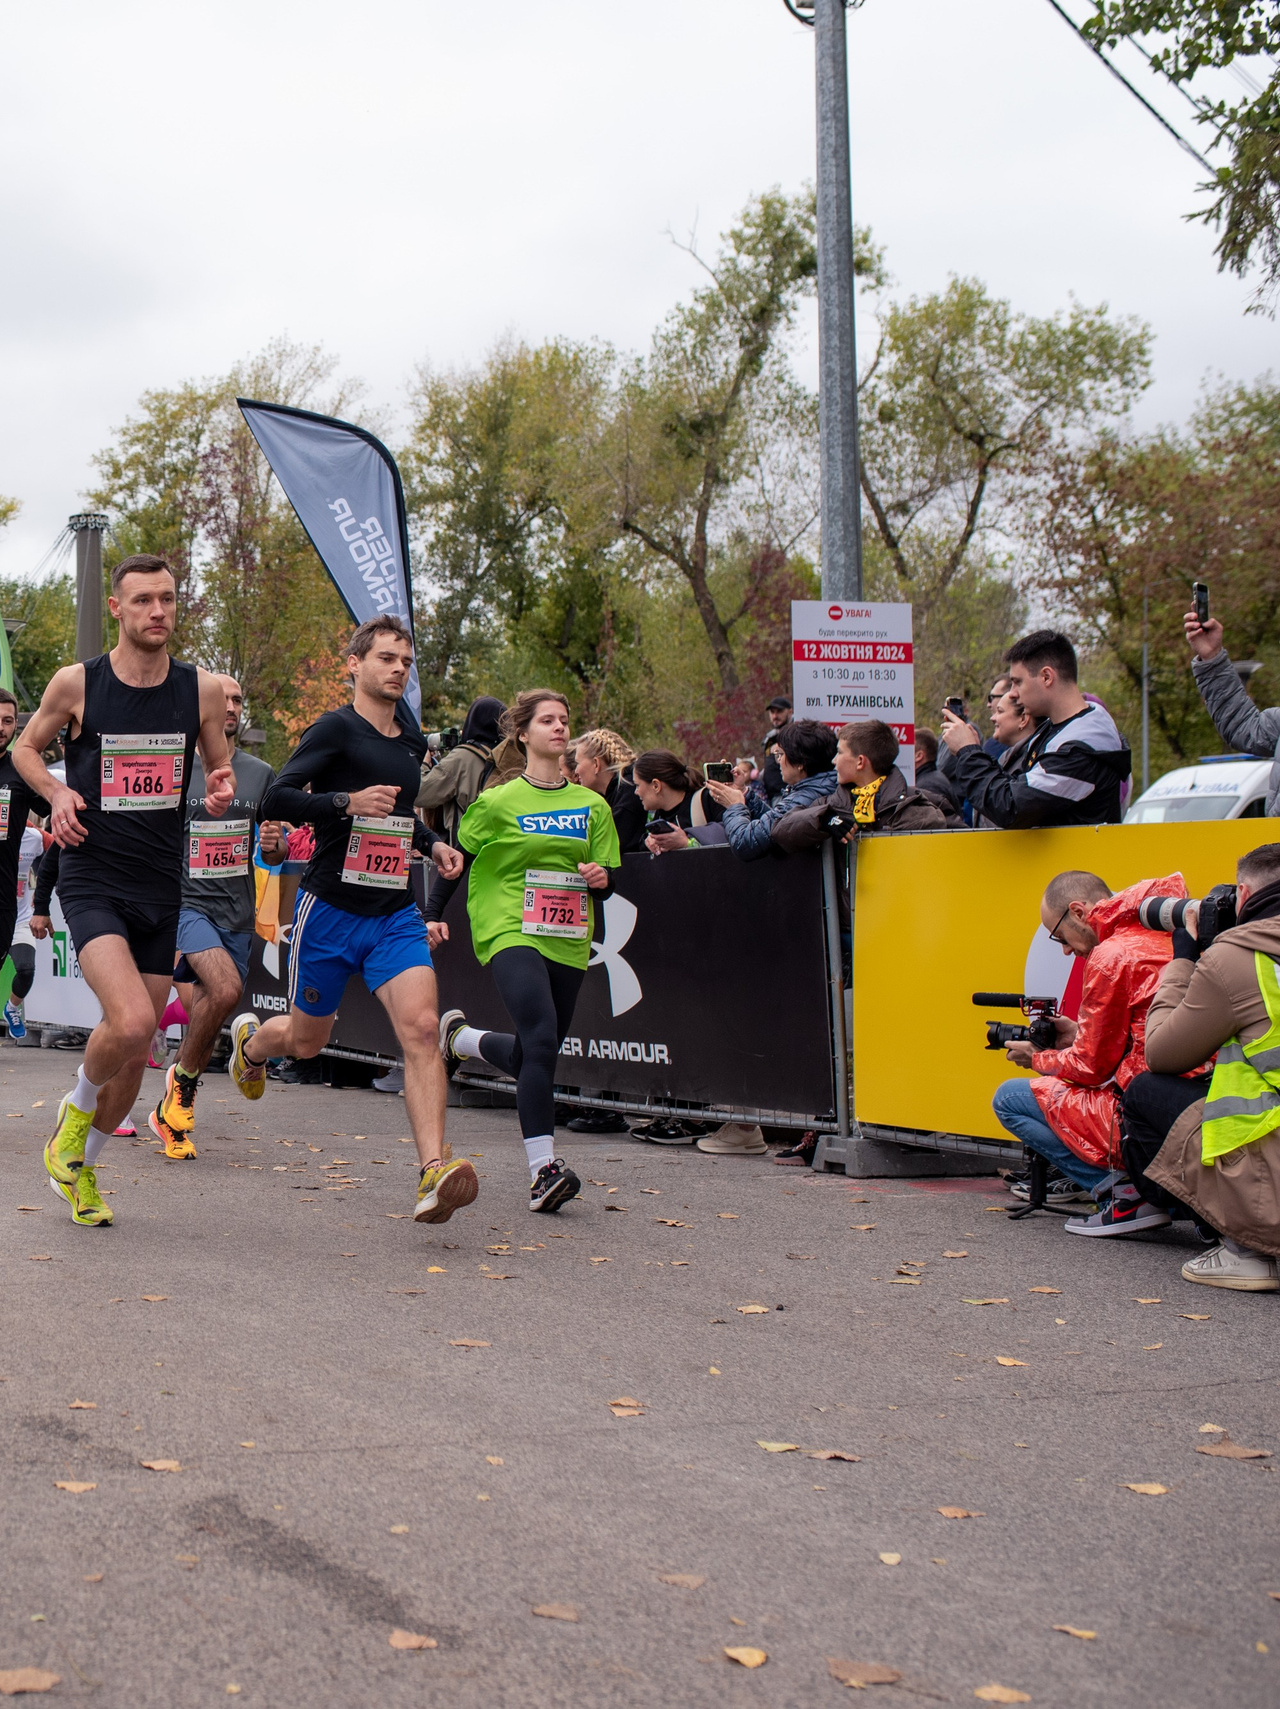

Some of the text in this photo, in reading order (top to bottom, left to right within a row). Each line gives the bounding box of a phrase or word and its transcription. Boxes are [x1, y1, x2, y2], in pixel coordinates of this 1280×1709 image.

[845, 609, 872, 618] УВАГА!
[818, 628, 888, 639] буде перекрито рух
[802, 643, 906, 661] 12 ЖОВТНЯ 2024
[812, 668, 896, 681] з 10:30 до 18:30
[826, 694, 904, 709] ТРУХАНІВСЬКА
[122, 776, 164, 795] 1686
[126, 800, 167, 808] ПриватБанк
[522, 814, 587, 832] START!
[205, 852, 236, 867] 1654
[365, 853, 400, 874] 1927
[541, 906, 575, 925] 1732
[252, 993, 287, 1013] UNDER
[558, 1036, 669, 1065] ER ARMOUR
